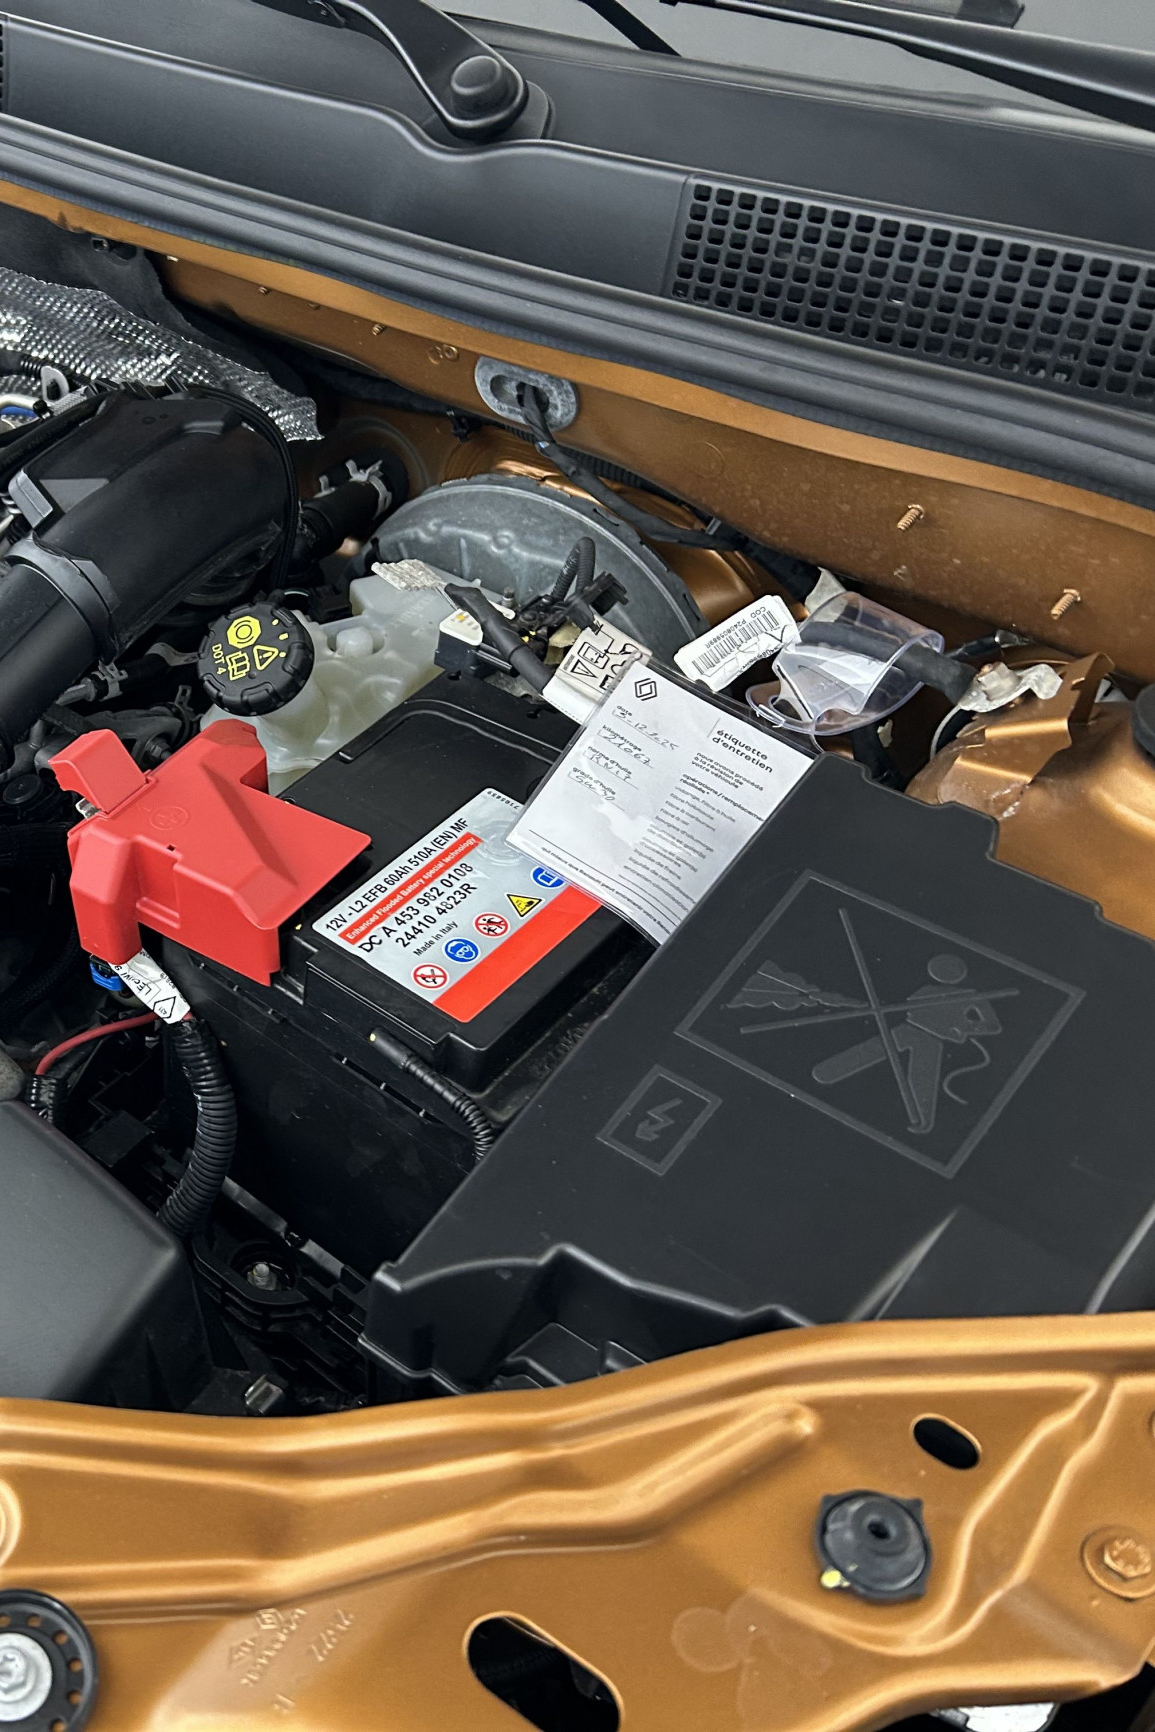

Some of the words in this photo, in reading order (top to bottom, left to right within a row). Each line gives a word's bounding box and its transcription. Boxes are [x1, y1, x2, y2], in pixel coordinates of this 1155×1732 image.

[749, 604, 767, 619] COD
[211, 643, 225, 663] DOT
[216, 666, 226, 674] 4
[616, 703, 633, 717] date
[711, 734, 773, 773] d'entretien
[715, 727, 768, 761] étiquette
[324, 913, 347, 931] 12V
[348, 897, 368, 913] L2
[361, 882, 388, 903] EFB
[382, 862, 412, 887] 60Ah
[407, 844, 437, 867] 510A
[430, 828, 458, 850] (EN)
[453, 817, 470, 835] MF
[345, 912, 379, 940] Enhanced
[376, 893, 403, 915] Flooded
[400, 877, 425, 897] Battery
[420, 860, 445, 881] special
[441, 835, 476, 863] technology
[357, 933, 383, 953] DC
[381, 925, 397, 938] A
[393, 904, 420, 928] 453
[415, 885, 444, 908] 982
[439, 861, 474, 888] 0108
[394, 913, 437, 947] 24410
[434, 882, 477, 917] 4823R
[412, 938, 435, 956] Made
[431, 932, 443, 941] in
[439, 920, 458, 935] Italy
